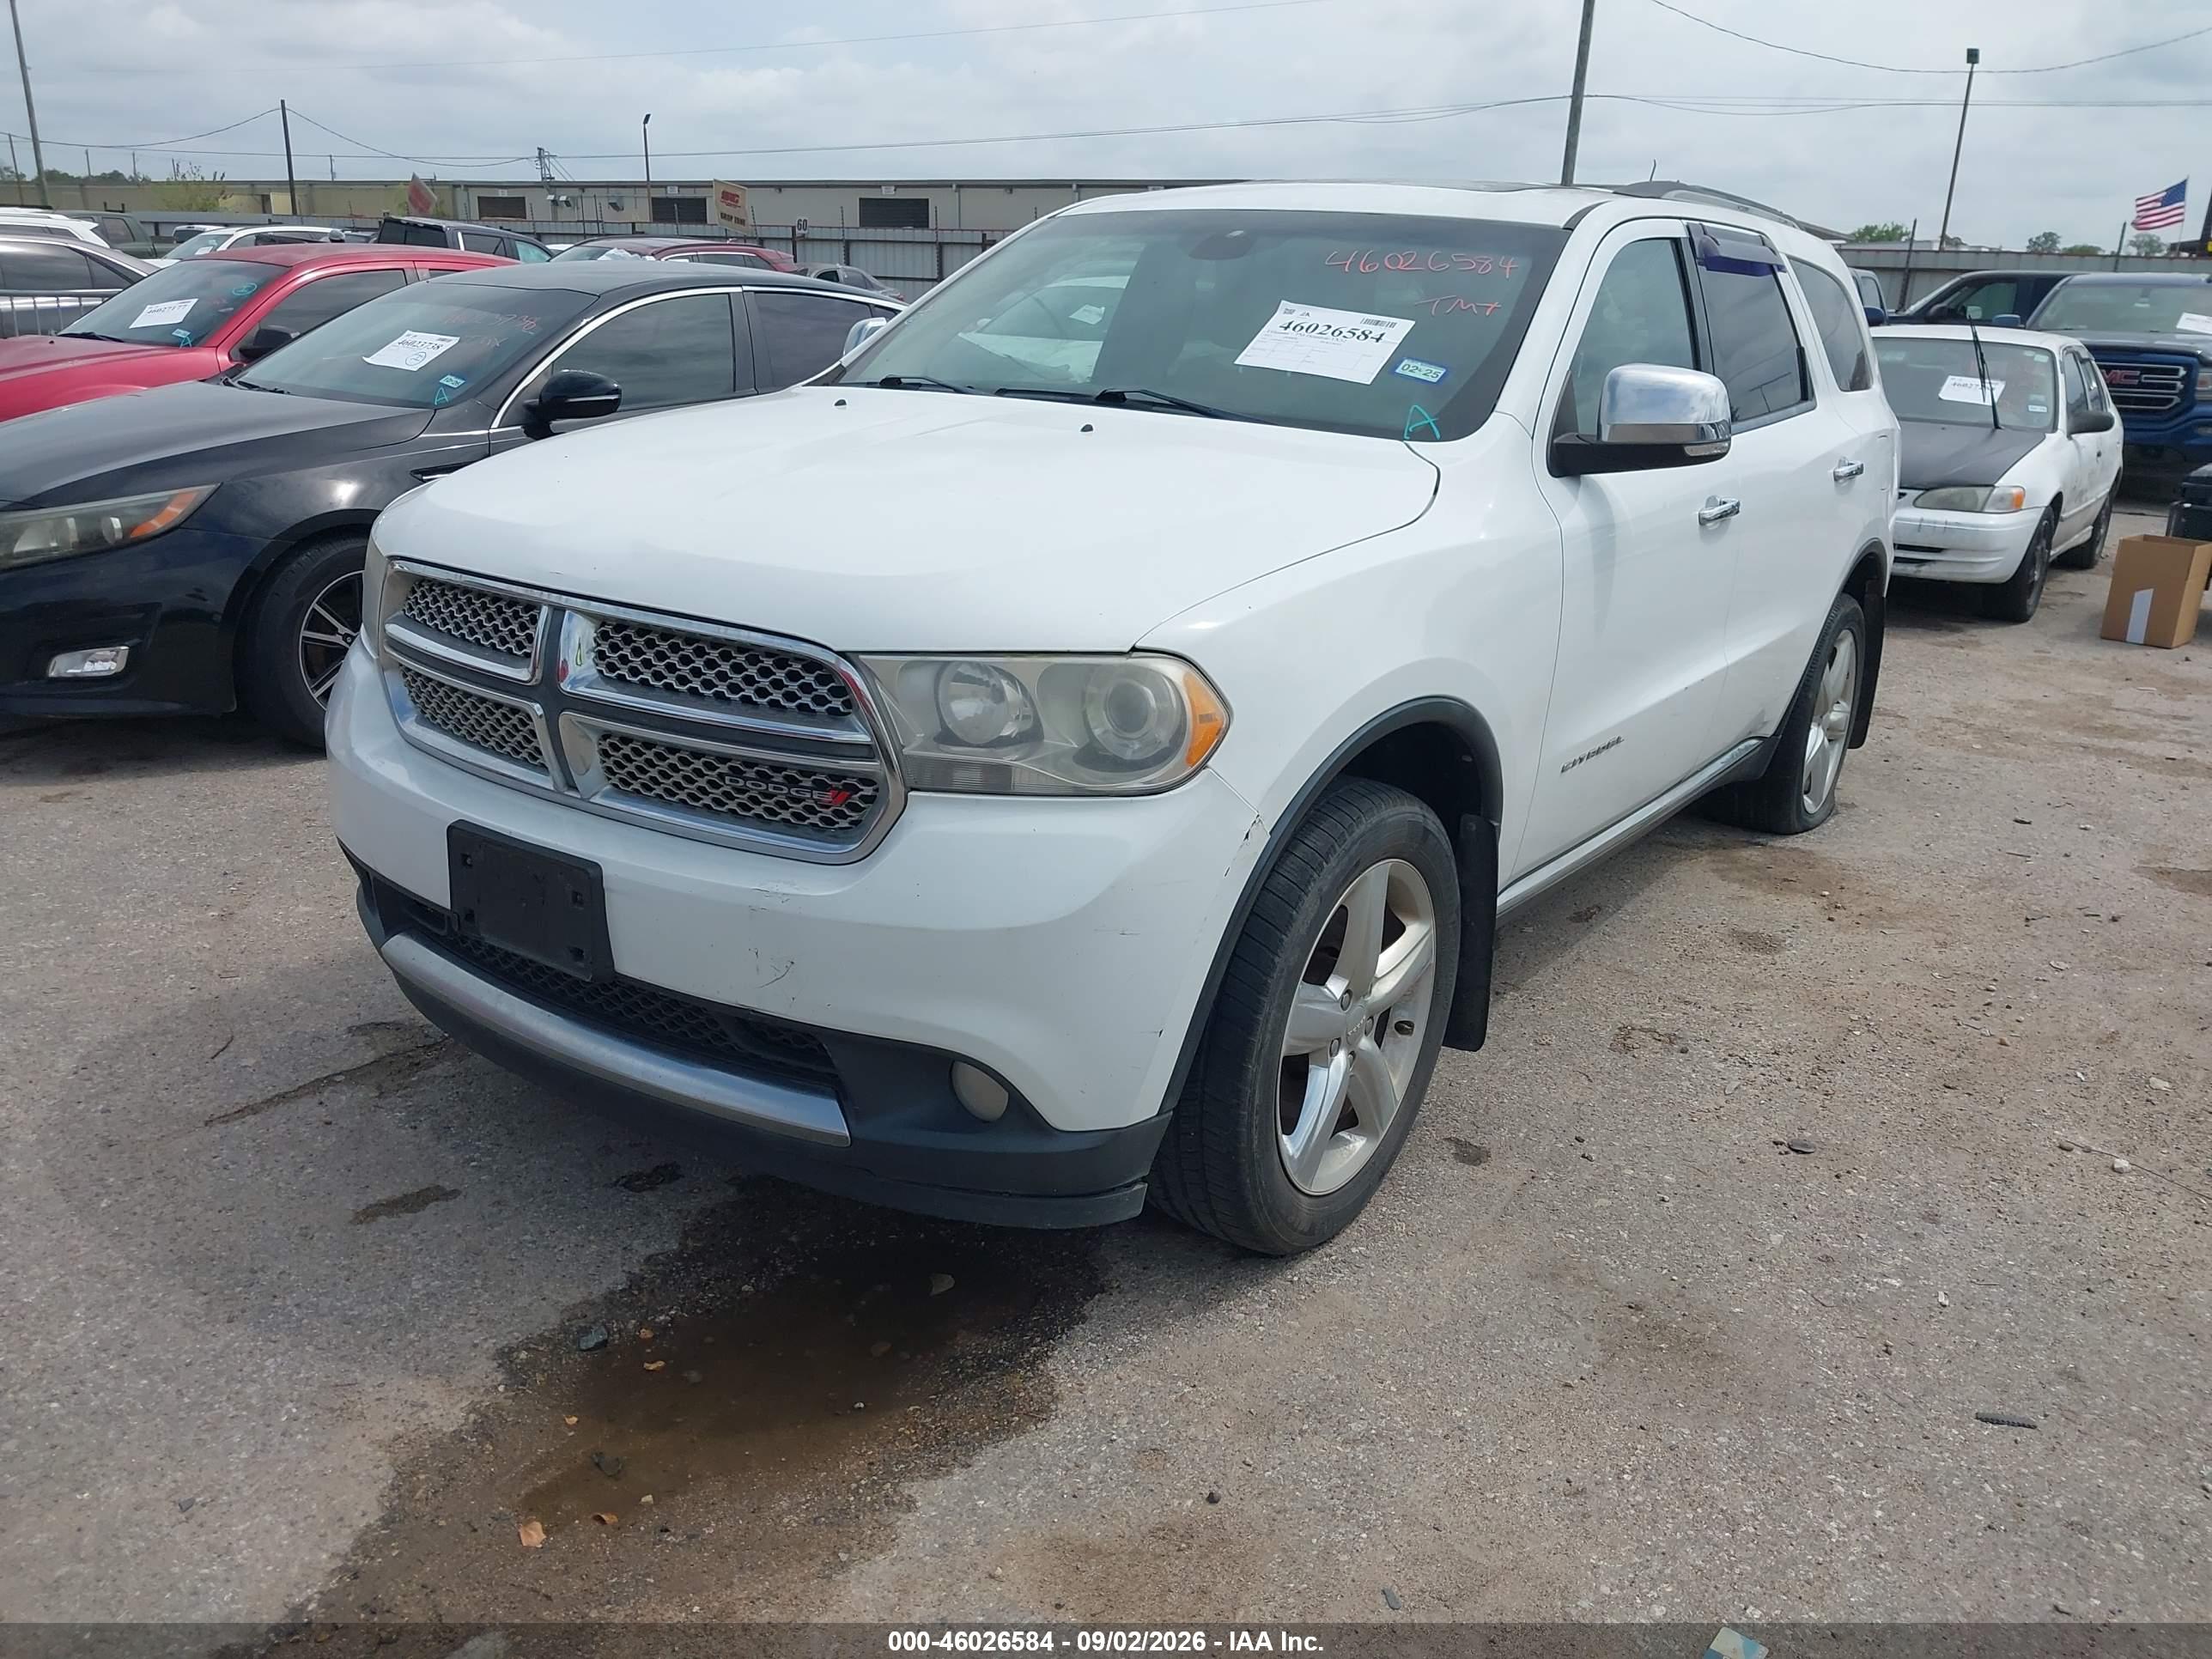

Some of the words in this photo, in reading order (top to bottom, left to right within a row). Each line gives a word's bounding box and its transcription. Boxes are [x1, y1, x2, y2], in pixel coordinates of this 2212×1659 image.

[797, 218, 808, 231] 60
[1325, 250, 1519, 278] 46026584
[1279, 319, 1387, 343] 46026584
[2100, 368, 2141, 386] MC
[434, 387, 449, 406] A
[1403, 404, 1441, 440] A
[725, 775, 833, 801] DODGE
